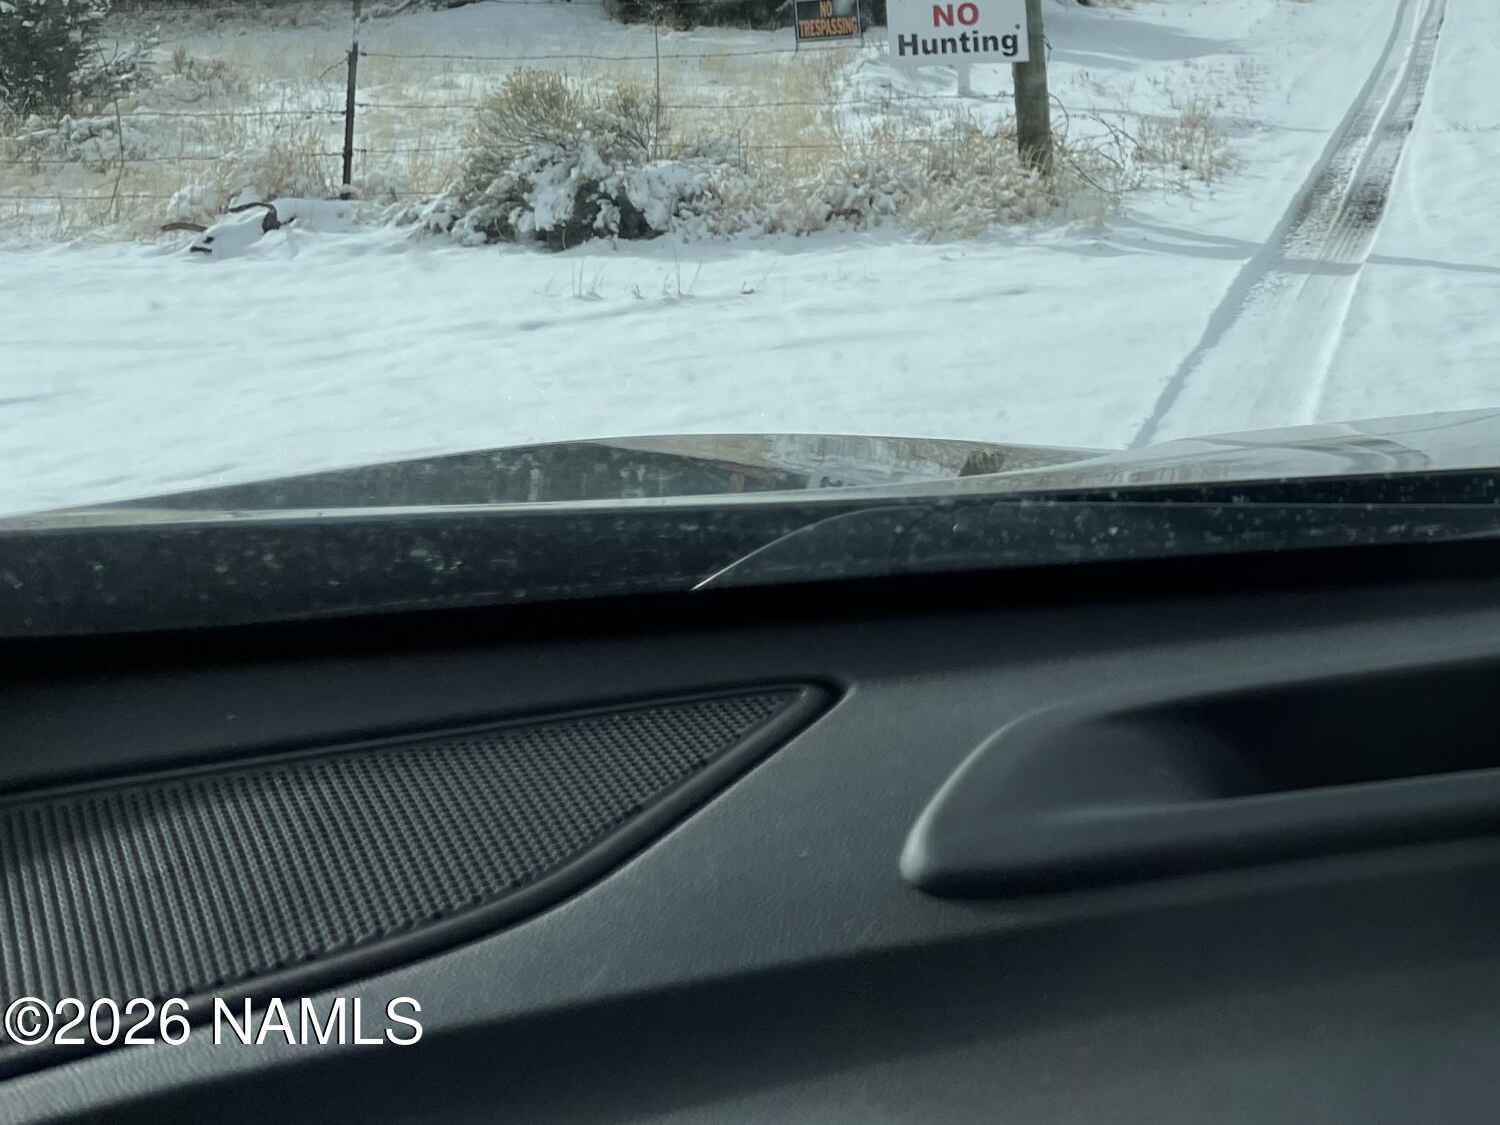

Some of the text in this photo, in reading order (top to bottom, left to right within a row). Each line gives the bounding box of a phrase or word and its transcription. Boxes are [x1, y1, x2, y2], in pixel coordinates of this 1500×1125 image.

[820, 0, 832, 17] NO
[933, 3, 979, 27] NO
[799, 17, 857, 37] TRESPASSING
[898, 31, 1018, 57] Hunting
